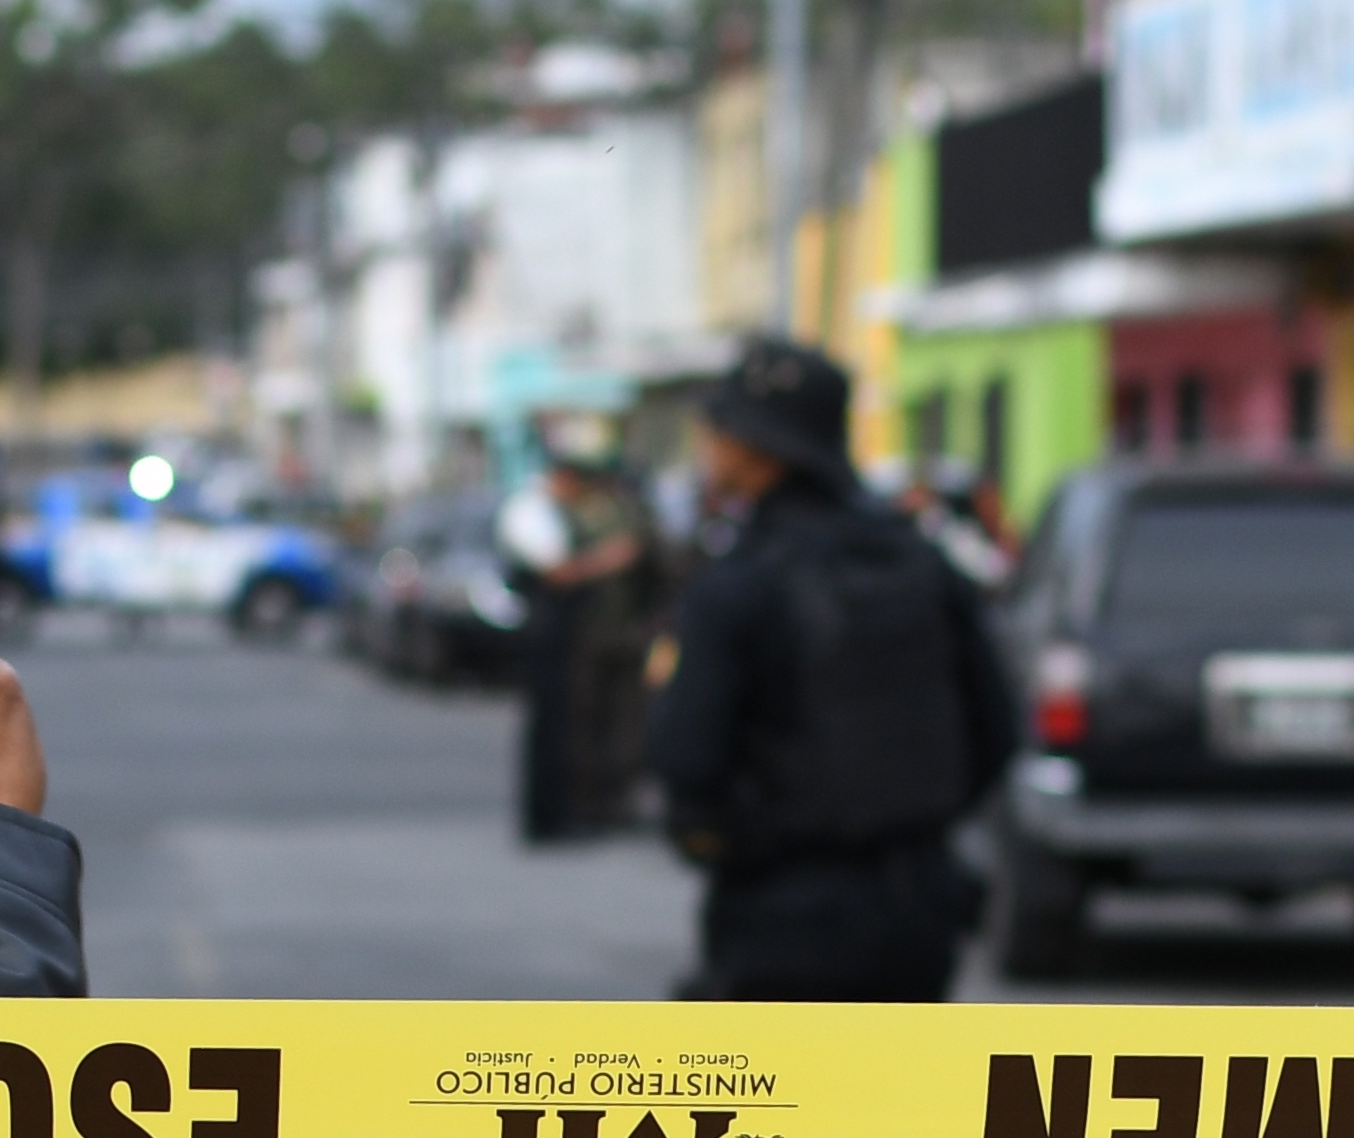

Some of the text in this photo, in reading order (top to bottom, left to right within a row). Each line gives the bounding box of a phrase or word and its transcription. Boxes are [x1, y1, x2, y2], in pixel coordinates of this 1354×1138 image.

[465, 1051, 750, 1071] Ciencia Verdad Justicia
[435, 1069, 777, 1101] MINISTERIO PÚBLICO
